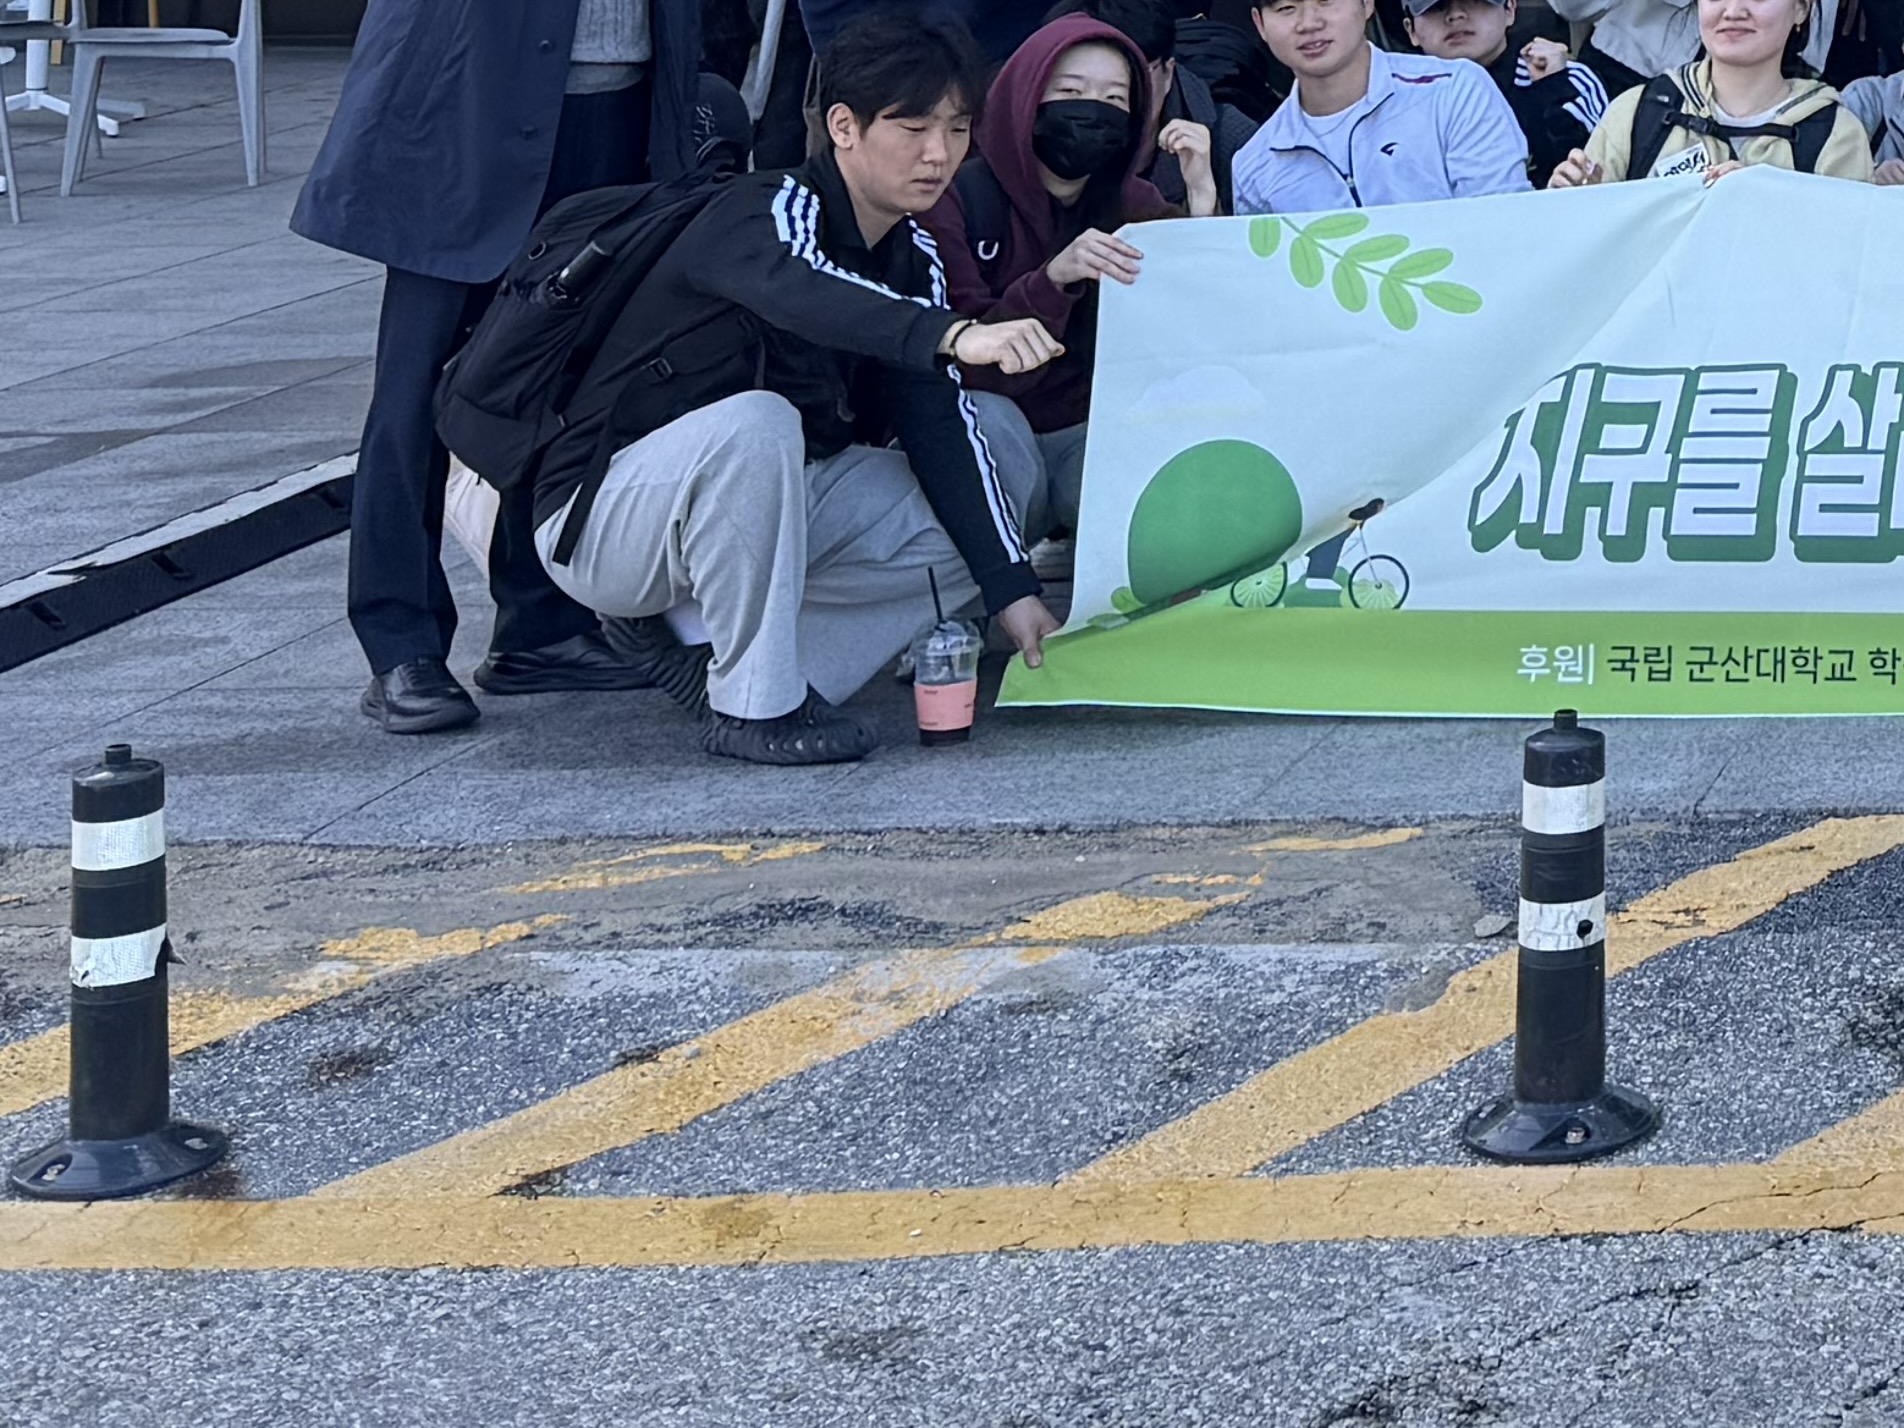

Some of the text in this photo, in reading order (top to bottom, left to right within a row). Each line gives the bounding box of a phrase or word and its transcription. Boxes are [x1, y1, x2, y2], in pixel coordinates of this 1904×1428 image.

[1470, 363, 1792, 554] 지구를
[1606, 644, 1673, 684] 국립
[1685, 644, 1858, 686] 군산대학교
